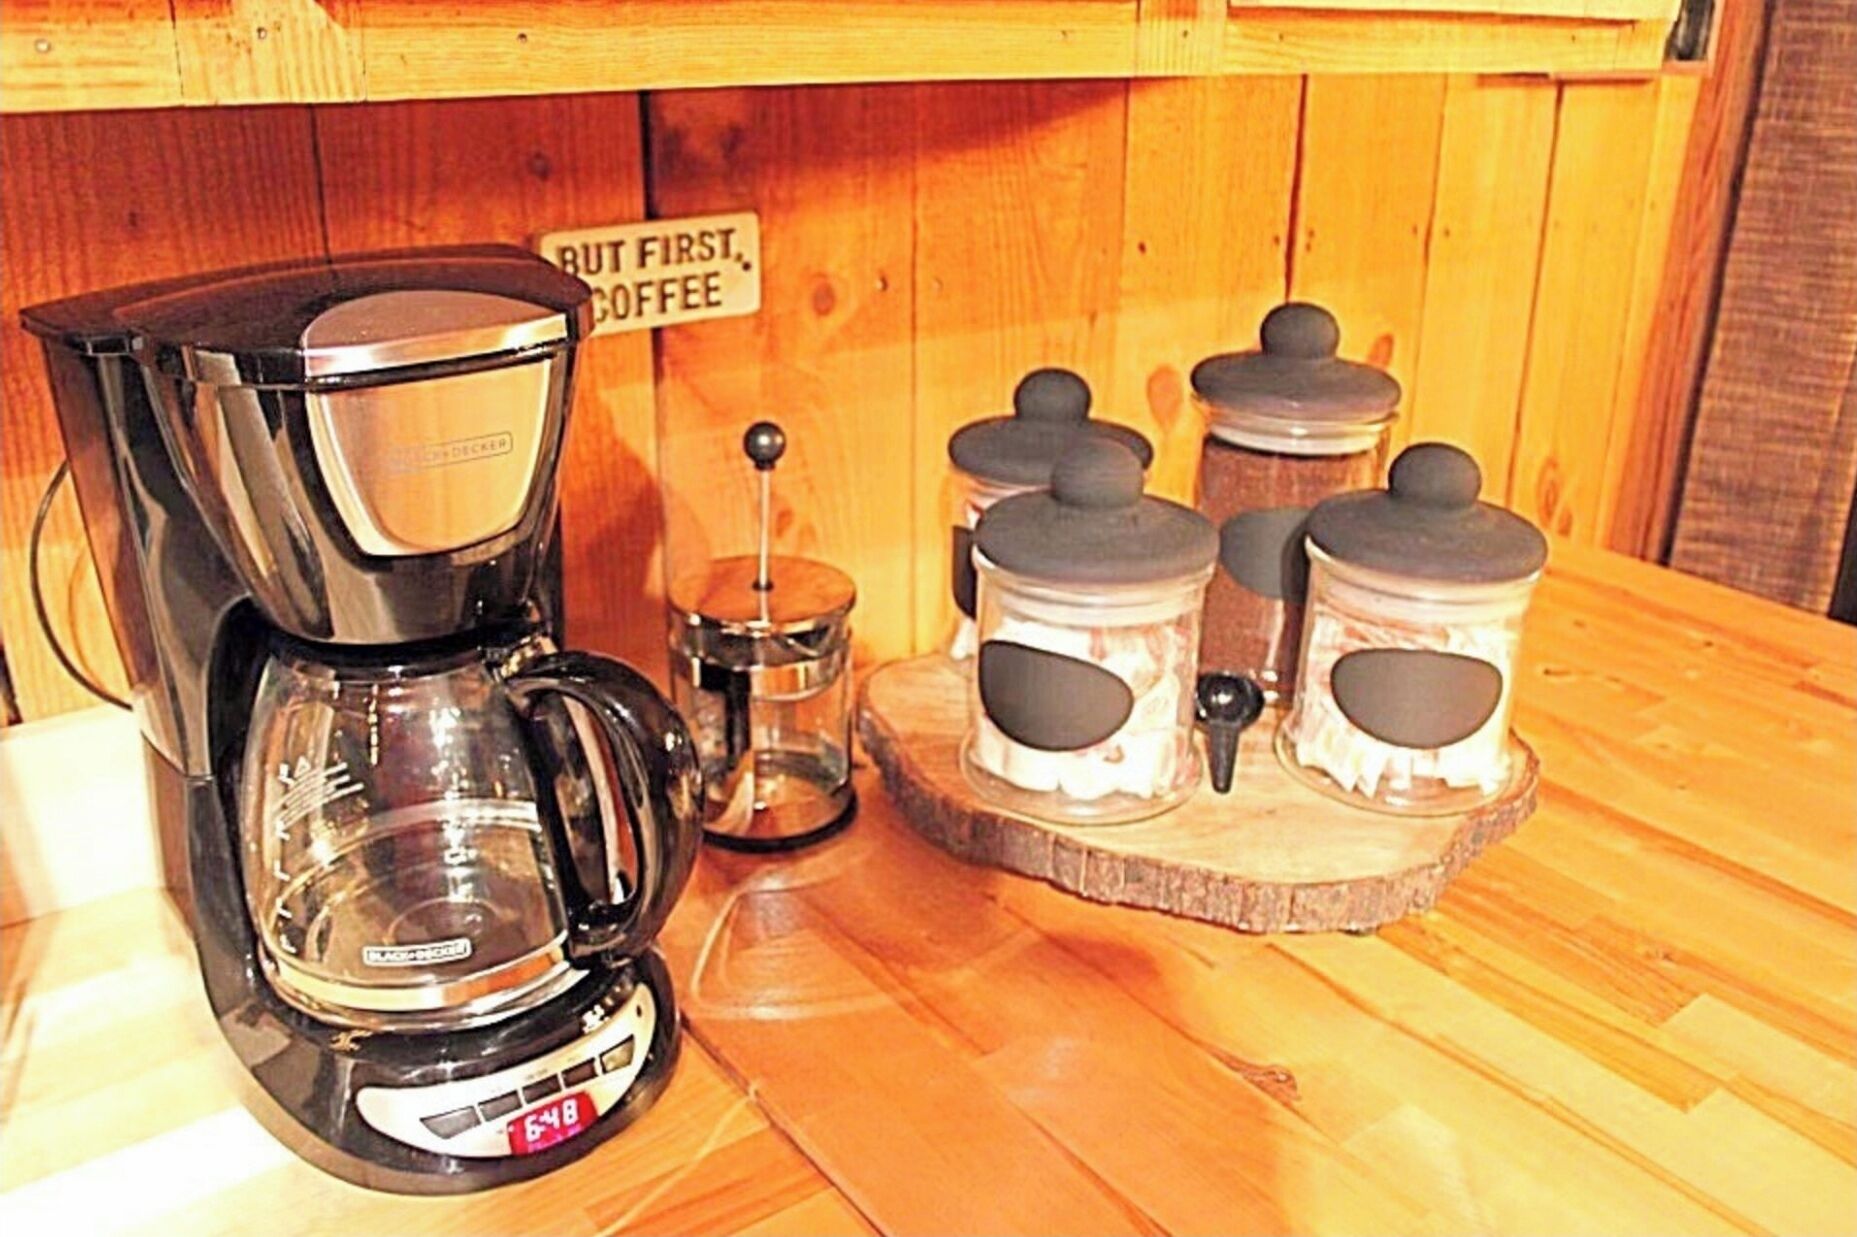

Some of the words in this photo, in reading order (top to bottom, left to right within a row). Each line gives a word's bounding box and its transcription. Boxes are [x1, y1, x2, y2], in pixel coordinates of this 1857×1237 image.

[558, 240, 624, 275] BUT
[637, 228, 743, 269] FIRST,
[593, 271, 722, 322] COFFEE
